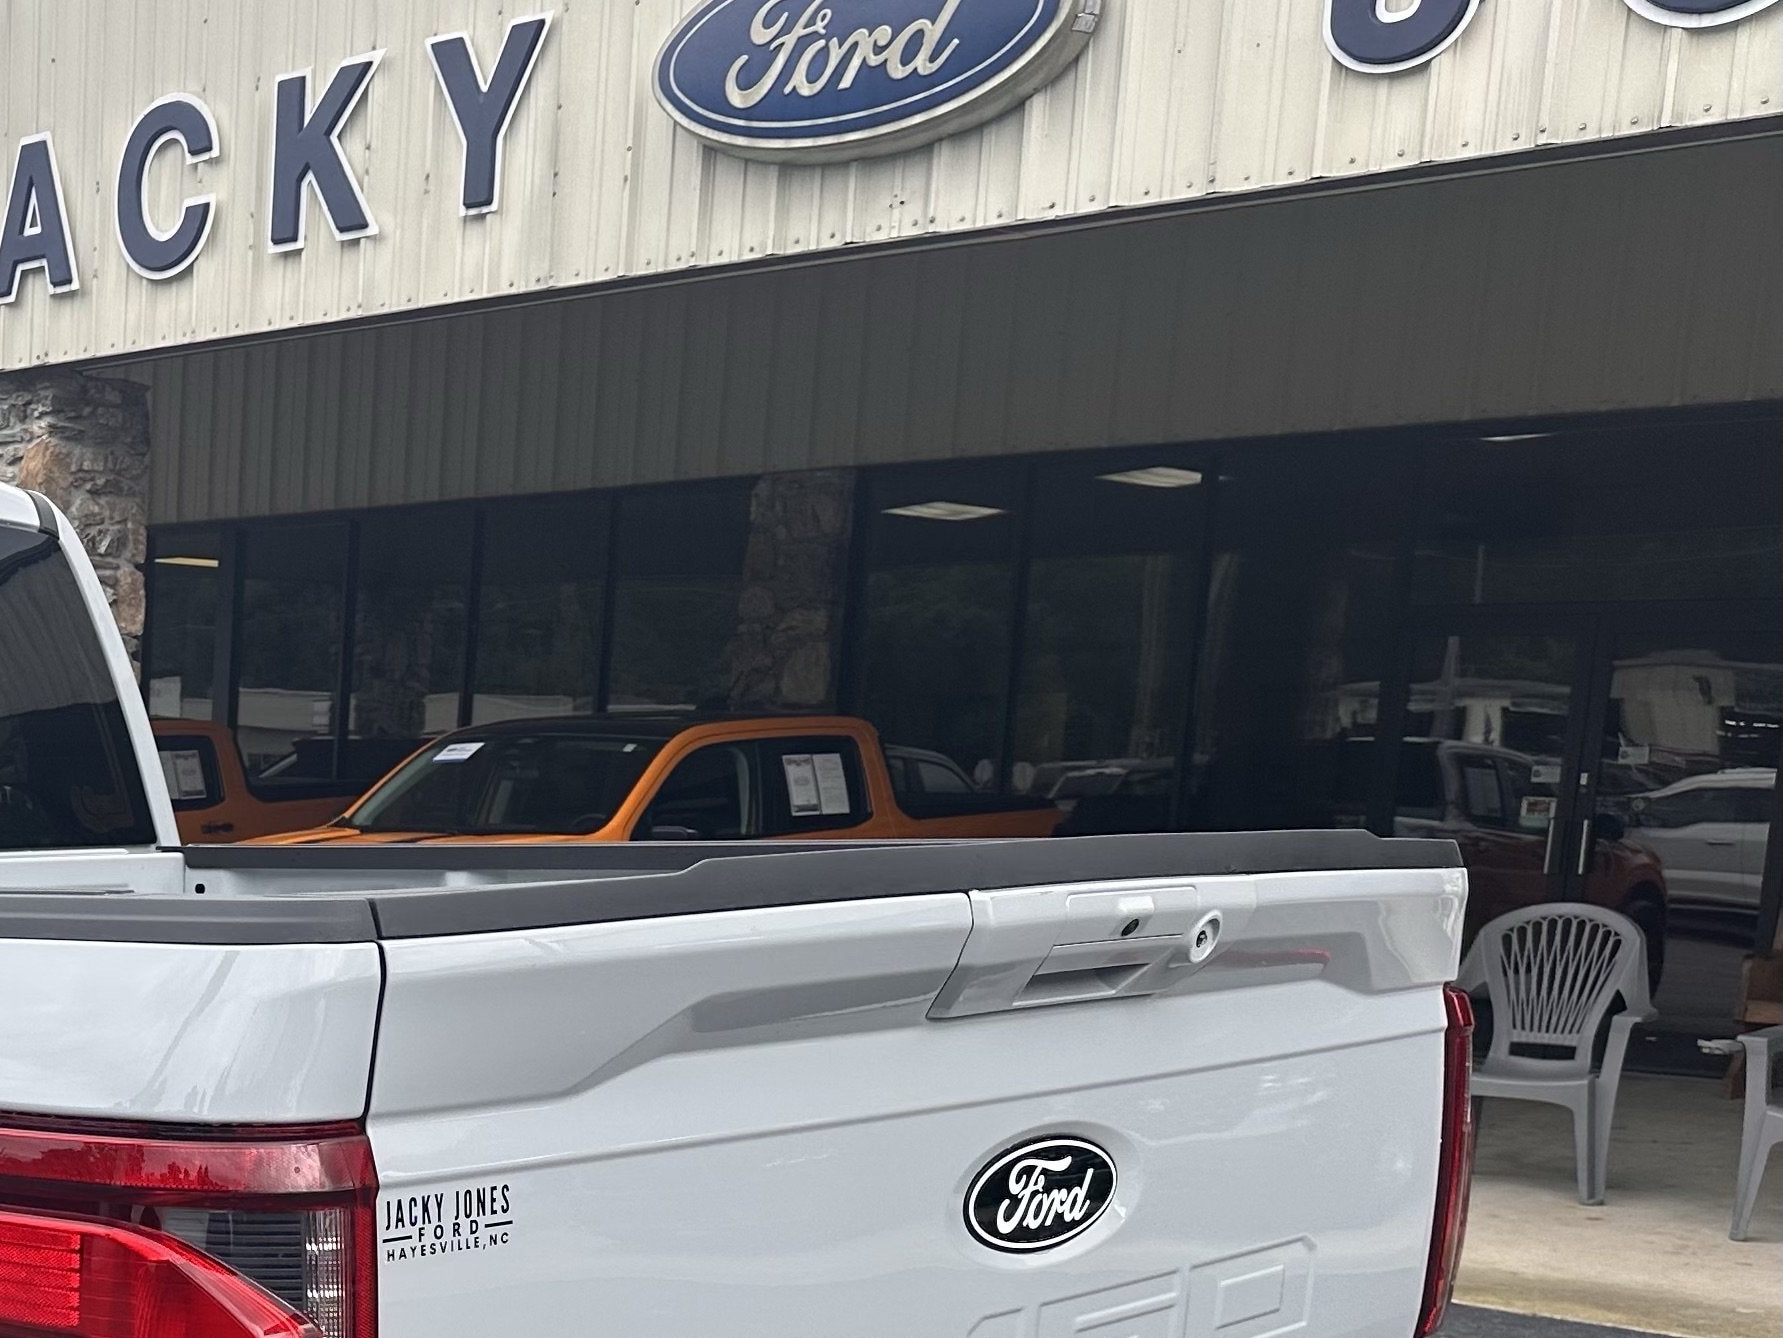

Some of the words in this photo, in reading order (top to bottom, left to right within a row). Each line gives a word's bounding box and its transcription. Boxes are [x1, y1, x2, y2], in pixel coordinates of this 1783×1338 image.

[725, 0, 960, 109] Ford
[385, 1192, 444, 1231] JACKY
[454, 1184, 510, 1221] JONES
[996, 1156, 1094, 1234] Ford
[418, 1219, 479, 1243] FORD
